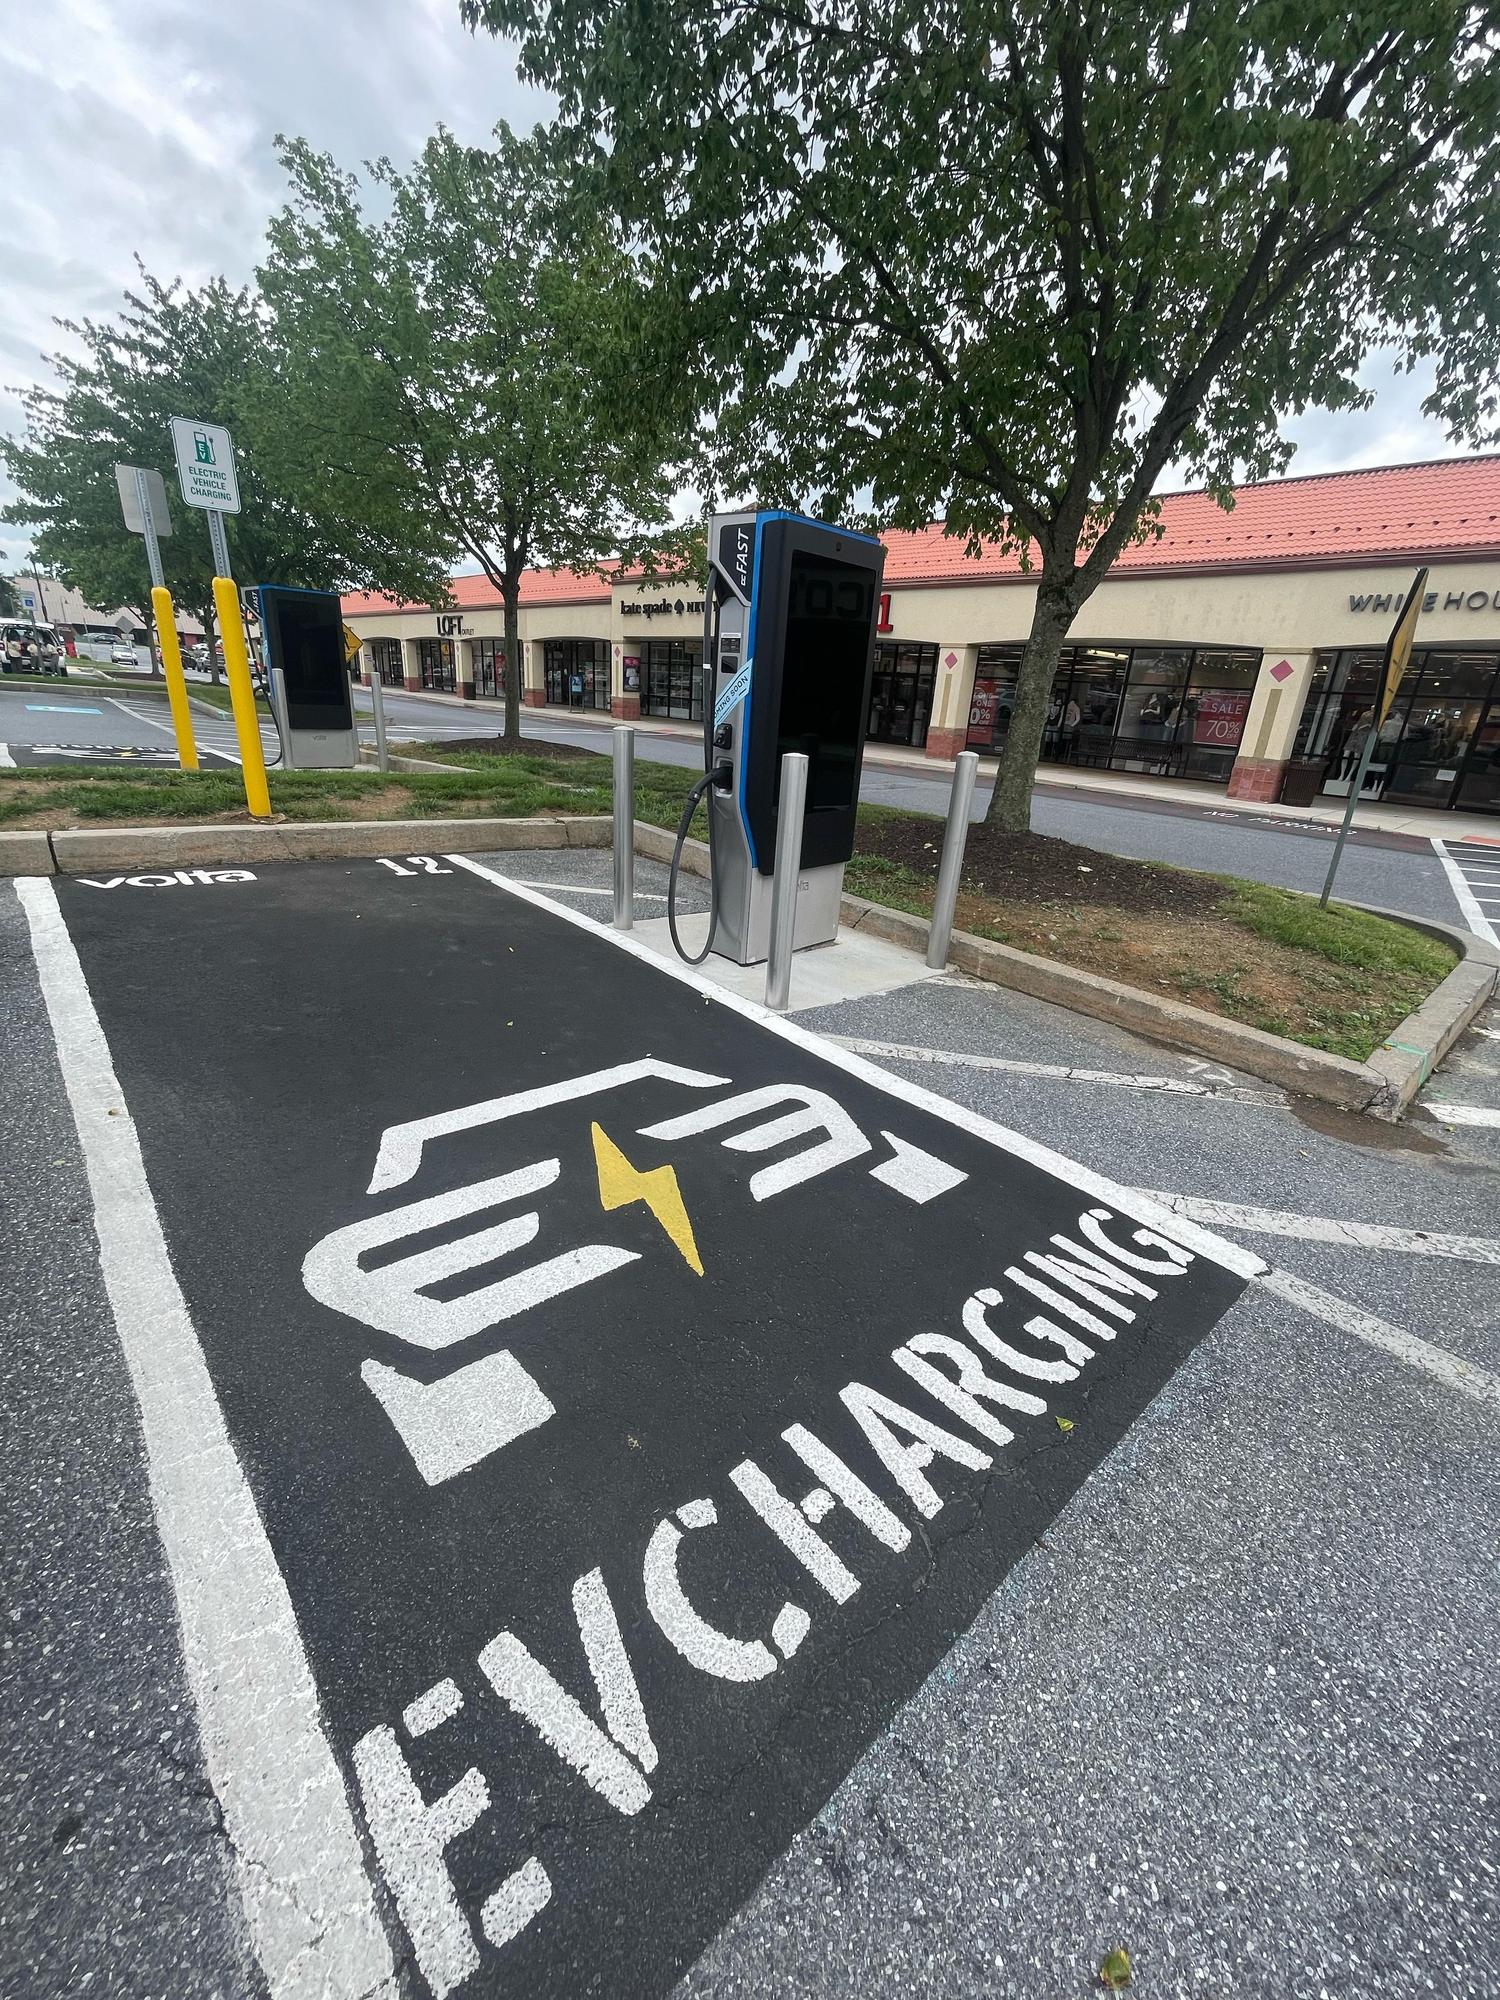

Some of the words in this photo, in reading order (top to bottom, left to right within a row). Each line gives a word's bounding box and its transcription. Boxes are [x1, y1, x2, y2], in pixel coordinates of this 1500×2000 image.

[199, 443, 206, 460] EV
[189, 466, 227, 480] ELECTRIC
[193, 477, 226, 490] VEHICLE
[191, 486, 232, 501] CHARGING
[735, 527, 749, 575] FAST
[620, 600, 642, 615] kate
[643, 598, 672, 620] spade
[1349, 592, 1439, 613] WHIE
[437, 614, 463, 636] LOFT
[730, 675, 749, 696] SOON
[970, 707, 991, 724] 0%
[1210, 702, 1244, 715] SALE
[1206, 719, 1241, 739] 70%
[374, 856, 455, 877] 12
[75, 868, 259, 889] volta
[351, 1566, 659, 2000] EV
[642, 1206, 1196, 1685] CHARGING
